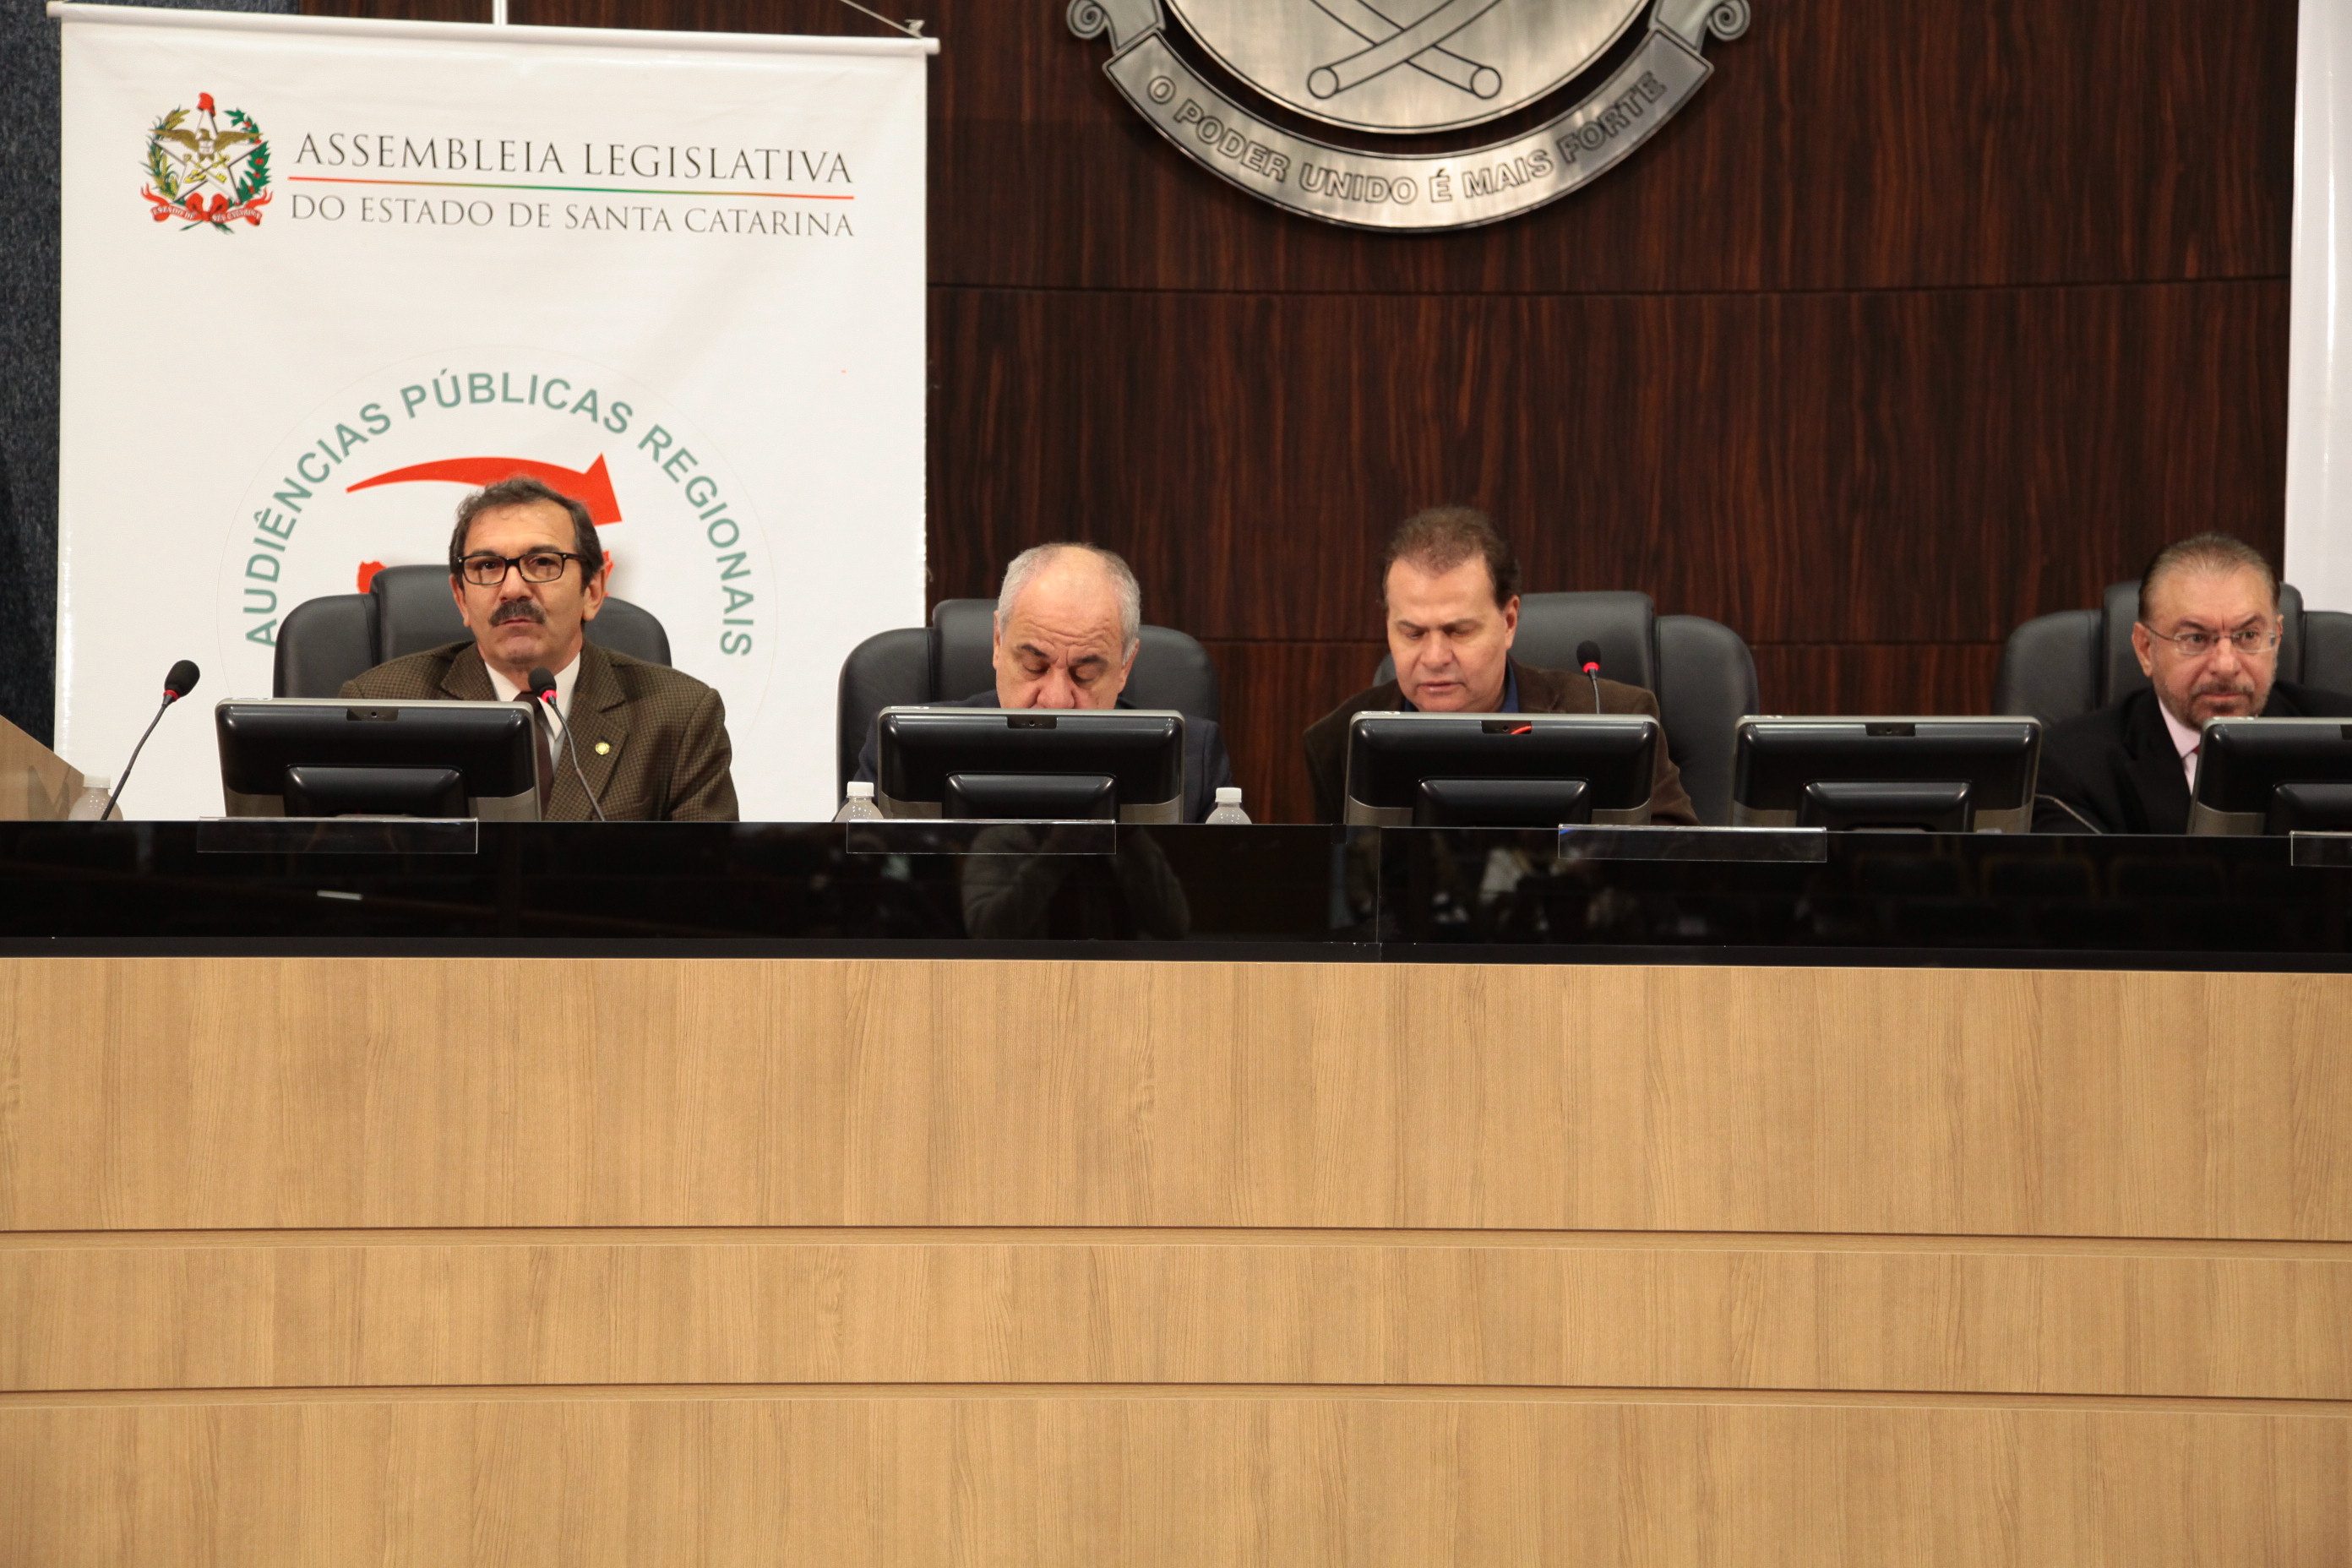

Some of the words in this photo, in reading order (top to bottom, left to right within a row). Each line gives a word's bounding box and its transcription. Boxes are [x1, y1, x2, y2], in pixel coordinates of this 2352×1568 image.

[294, 132, 567, 173] ASSEMBLEIA
[584, 143, 853, 183] LEGISLATIVA
[1146, 76, 1177, 104] O
[1173, 99, 1291, 182] PODER
[1299, 163, 1418, 204] UNIDO
[1429, 169, 1451, 203] É
[1462, 149, 1554, 199] MAIS
[1556, 71, 1667, 165] FORTE
[291, 194, 345, 221] DO
[362, 197, 494, 226] ESTADO
[509, 202, 550, 228] DE
[565, 204, 672, 231] SANTA
[684, 208, 854, 237] CATARINA
[243, 401, 392, 648] AUDIÊNCIAS
[400, 368, 634, 435] PÚBLICAS
[637, 424, 755, 658] REGIONAIS
